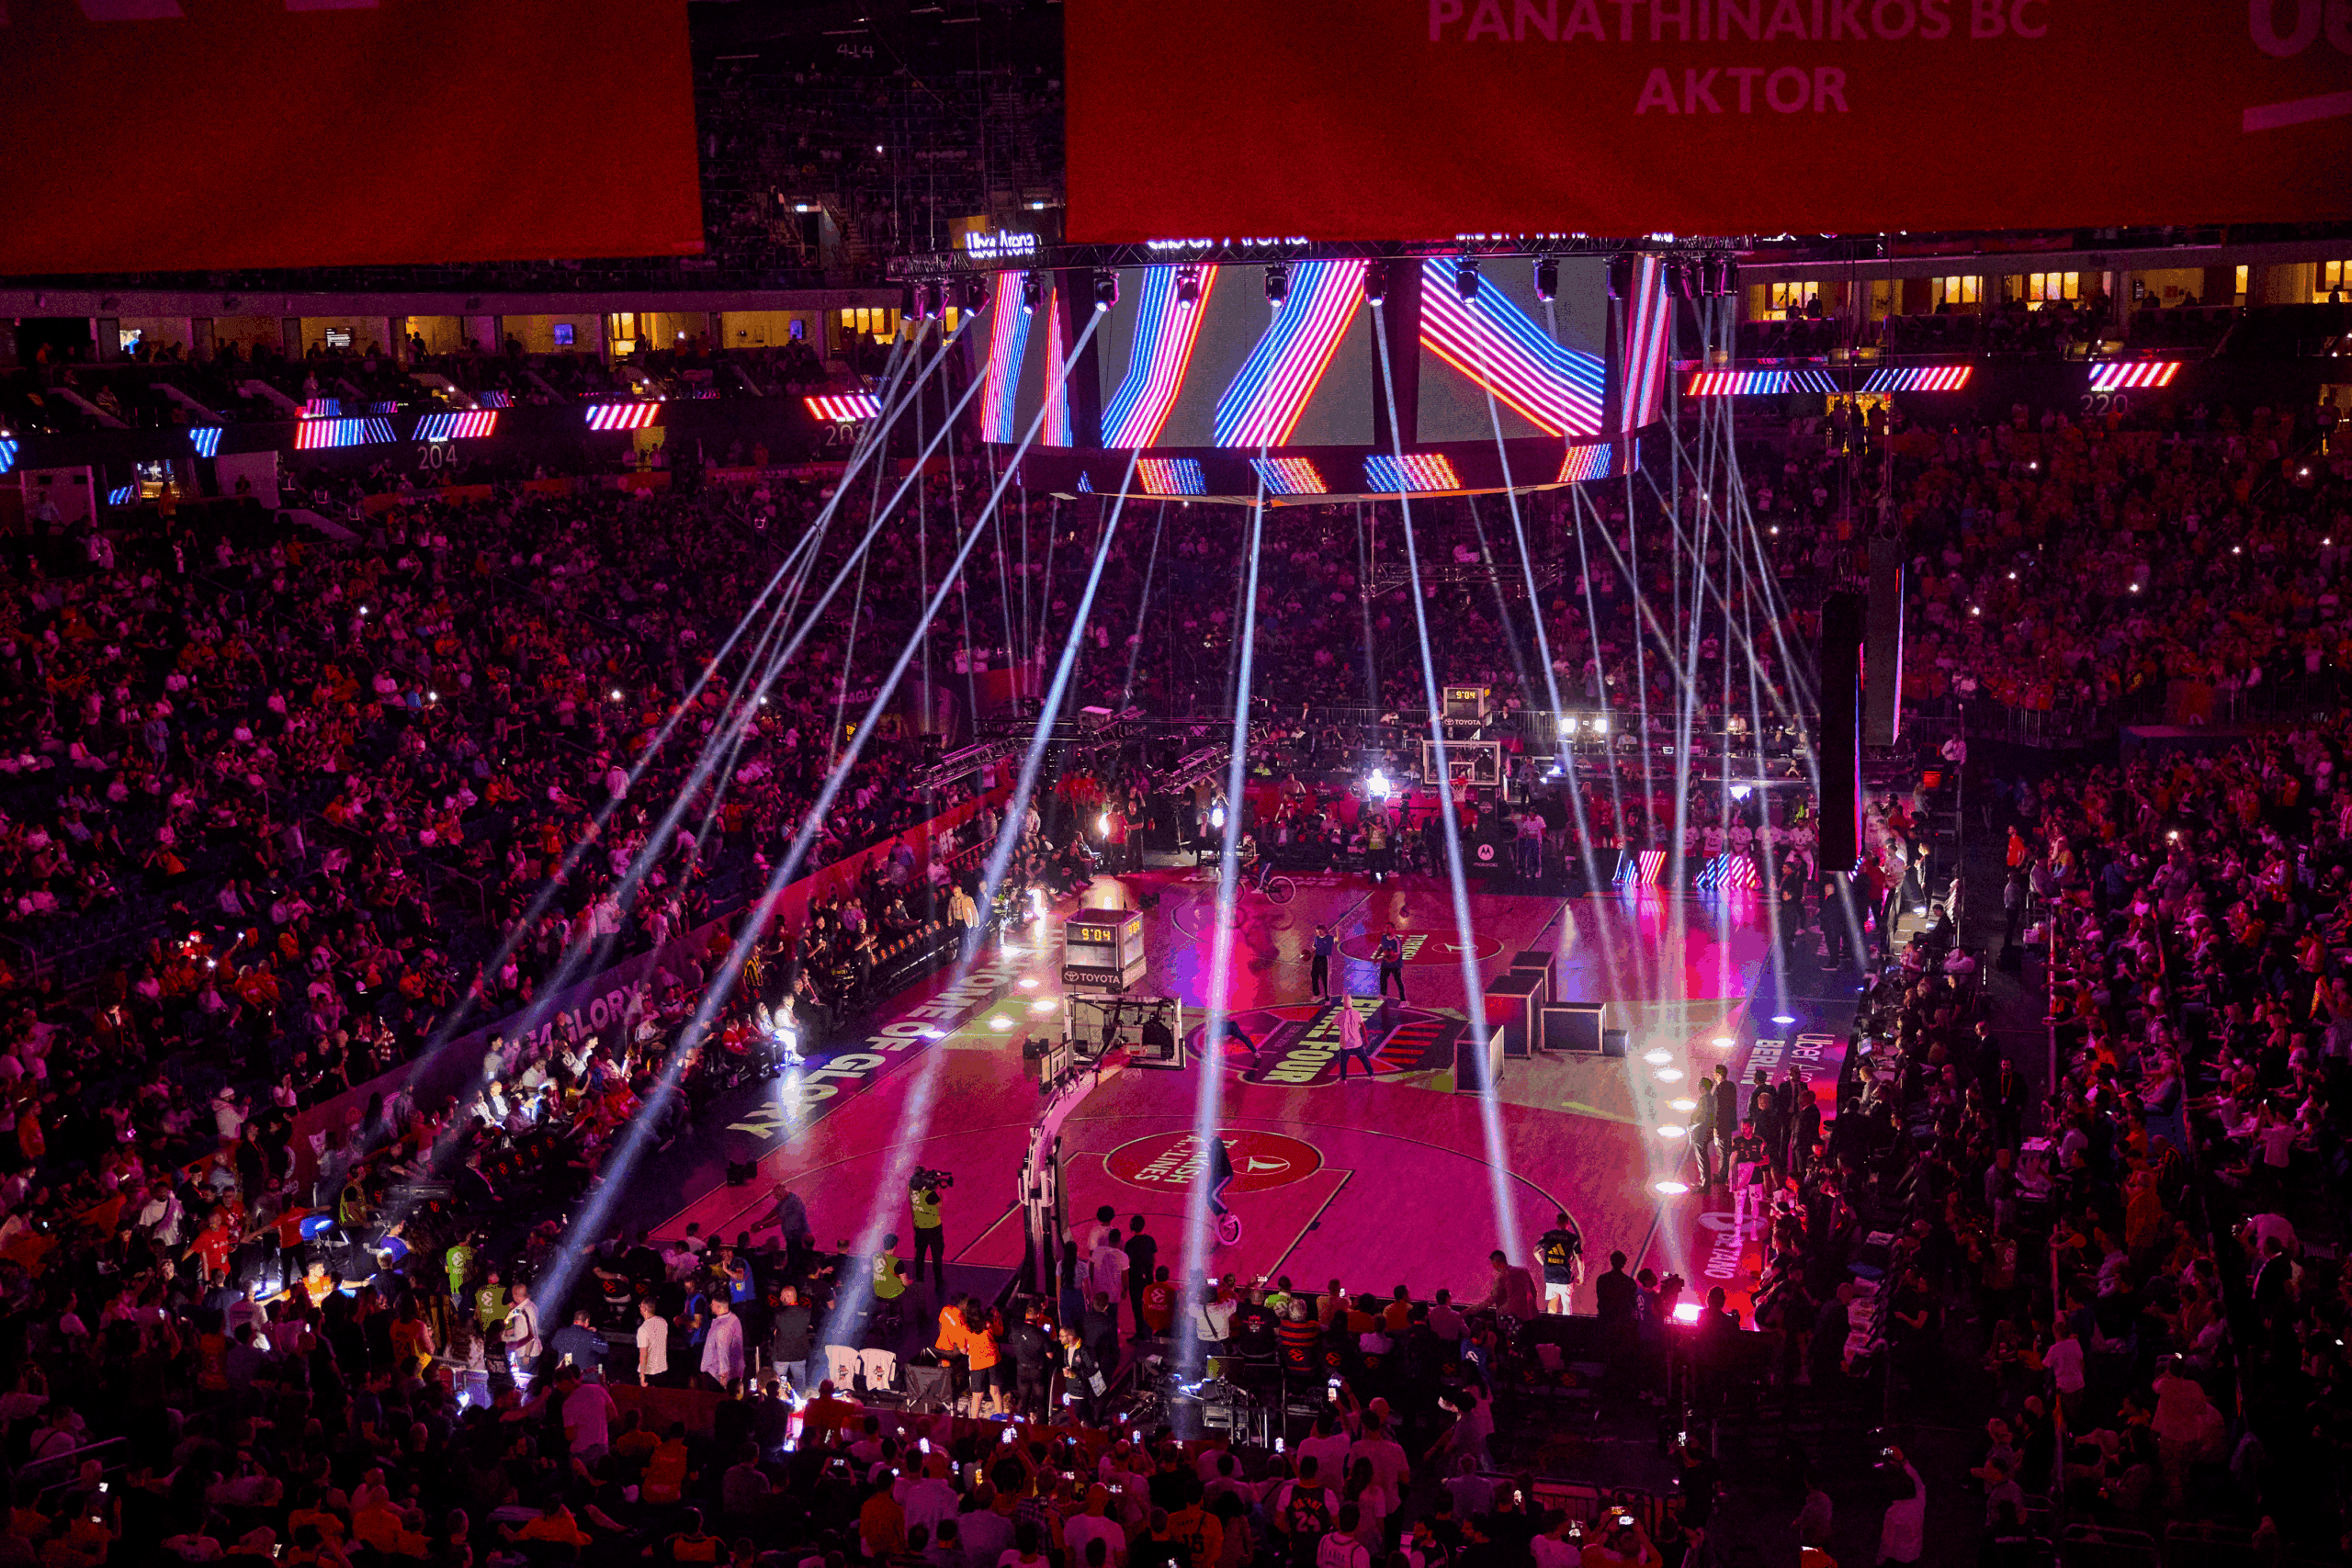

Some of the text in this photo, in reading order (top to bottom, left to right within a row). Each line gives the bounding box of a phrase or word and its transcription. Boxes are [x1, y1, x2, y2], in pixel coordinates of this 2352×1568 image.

[1429, 0, 2048, 41] PANATHINAIKOS BC
[836, 43, 875, 59] 414
[1634, 66, 1849, 114] AKTOR
[417, 445, 458, 469] 204
[1080, 973, 1121, 984] TOYOTA
[865, 1021, 935, 1052] OF
[1791, 1033, 1836, 1062] Uber
[1262, 1040, 1341, 1083] FOUR
